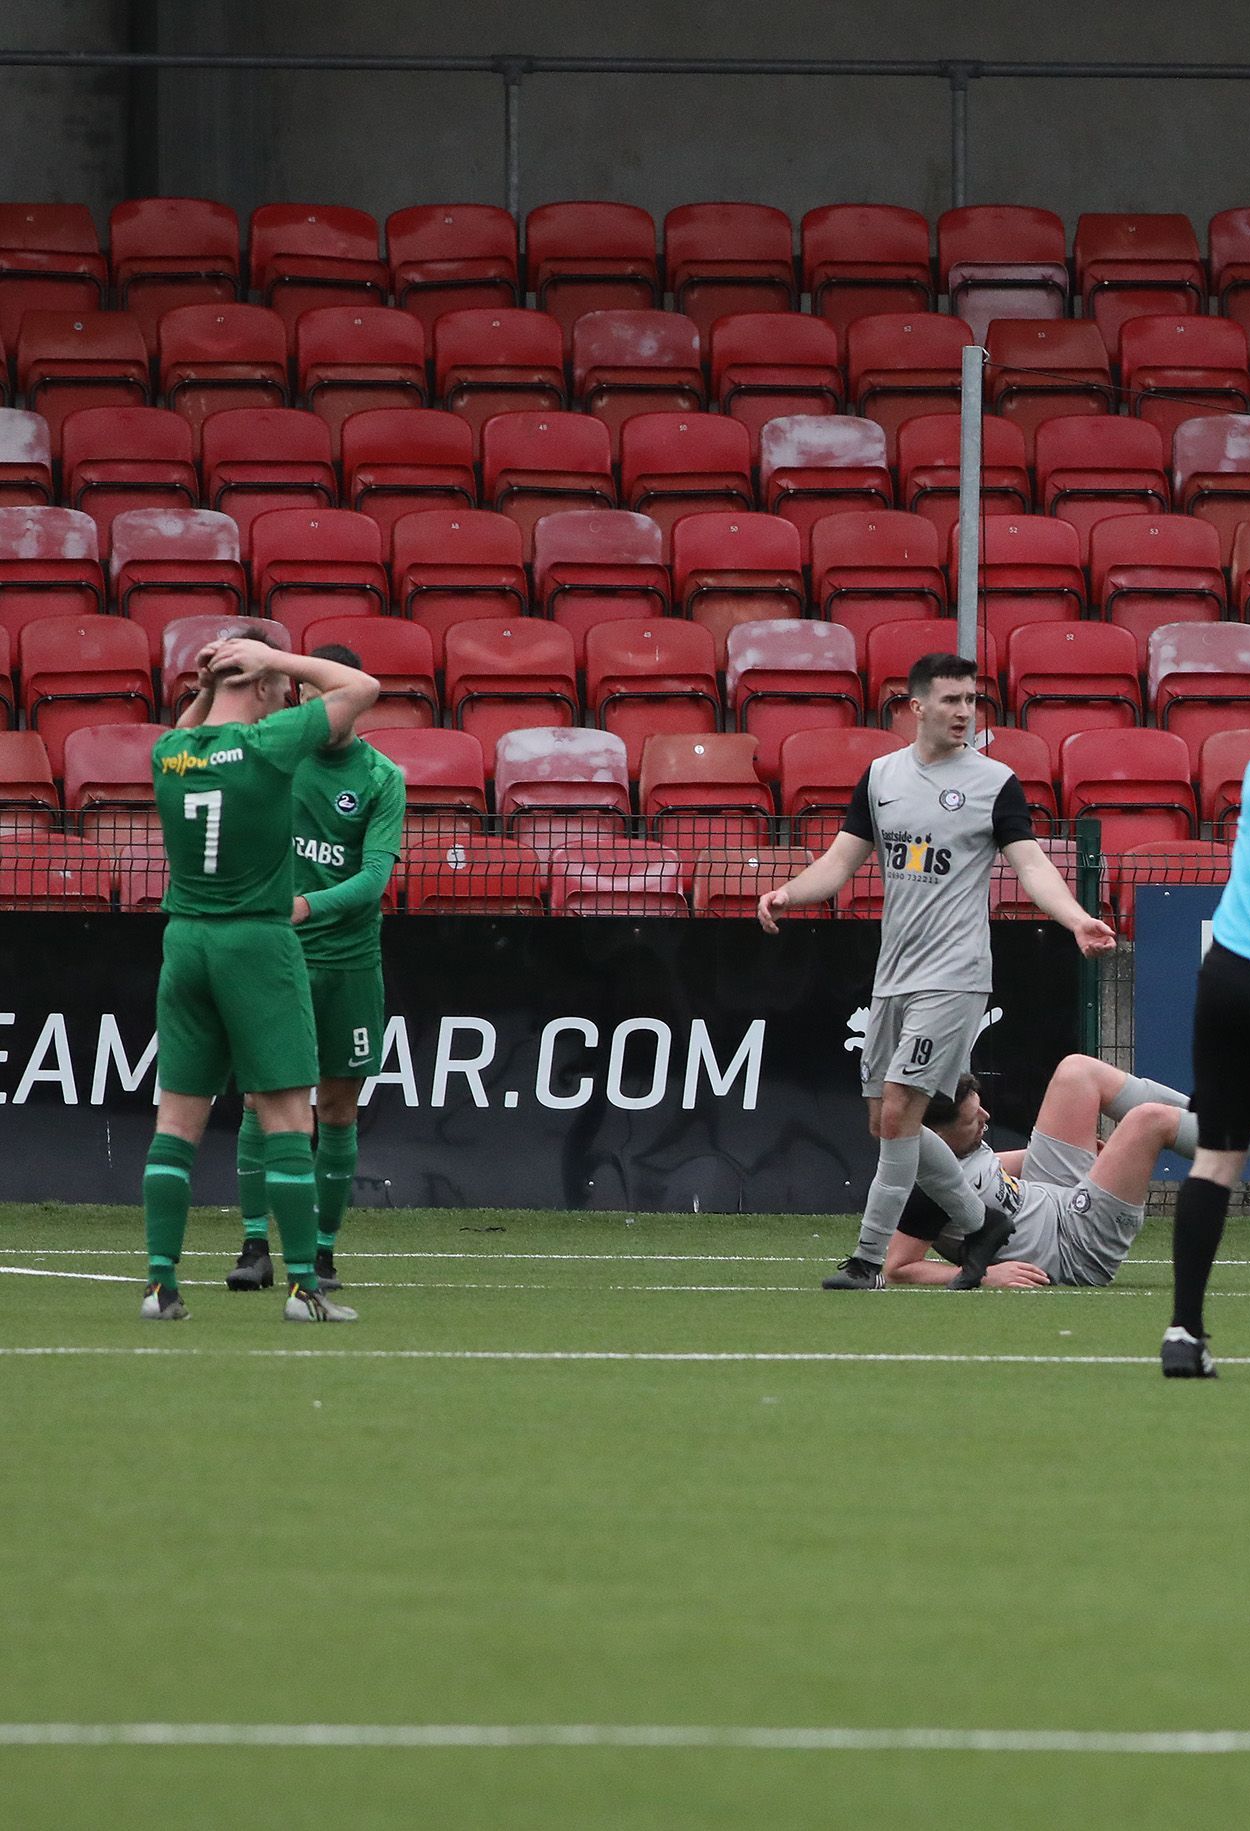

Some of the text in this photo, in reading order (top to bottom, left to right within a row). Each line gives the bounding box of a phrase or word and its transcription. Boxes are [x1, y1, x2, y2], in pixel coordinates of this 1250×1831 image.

[183, 789, 222, 874] 7
[352, 1026, 369, 1057] 9
[910, 1036, 934, 1066] 19
